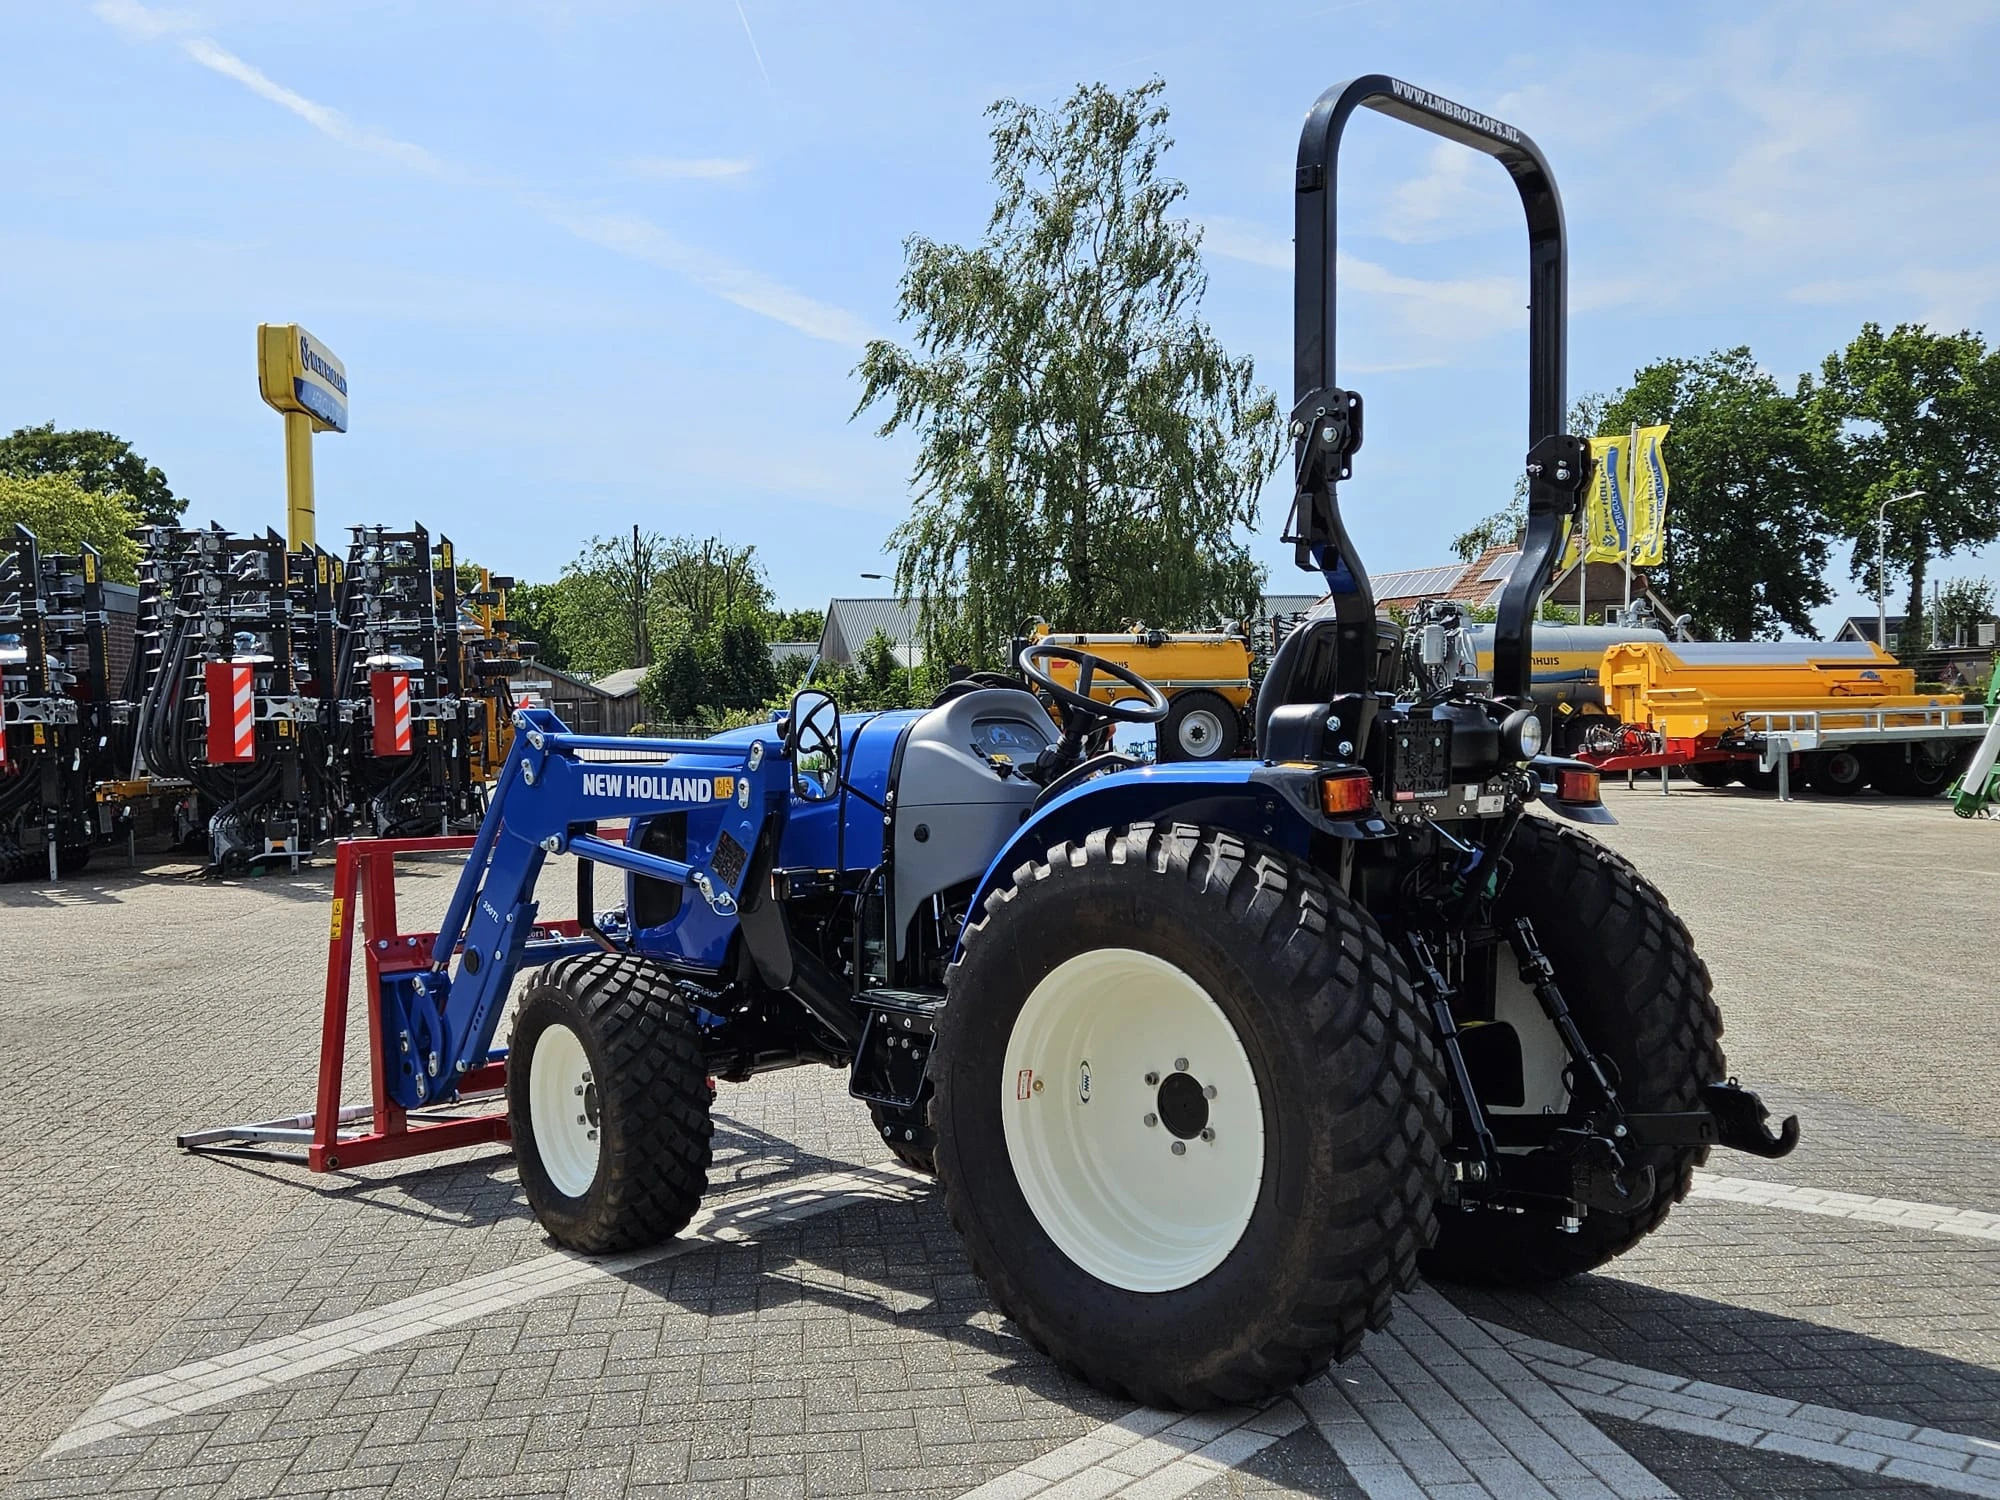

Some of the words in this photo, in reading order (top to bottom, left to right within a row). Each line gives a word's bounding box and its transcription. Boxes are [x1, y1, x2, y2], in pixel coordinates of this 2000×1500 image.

[1391, 79, 1520, 143] WWW.LMBROELOFS.NL
[1608, 471, 1626, 531] AGRICULTURE
[583, 773, 623, 798] NEW
[626, 775, 712, 803] HOLLAND
